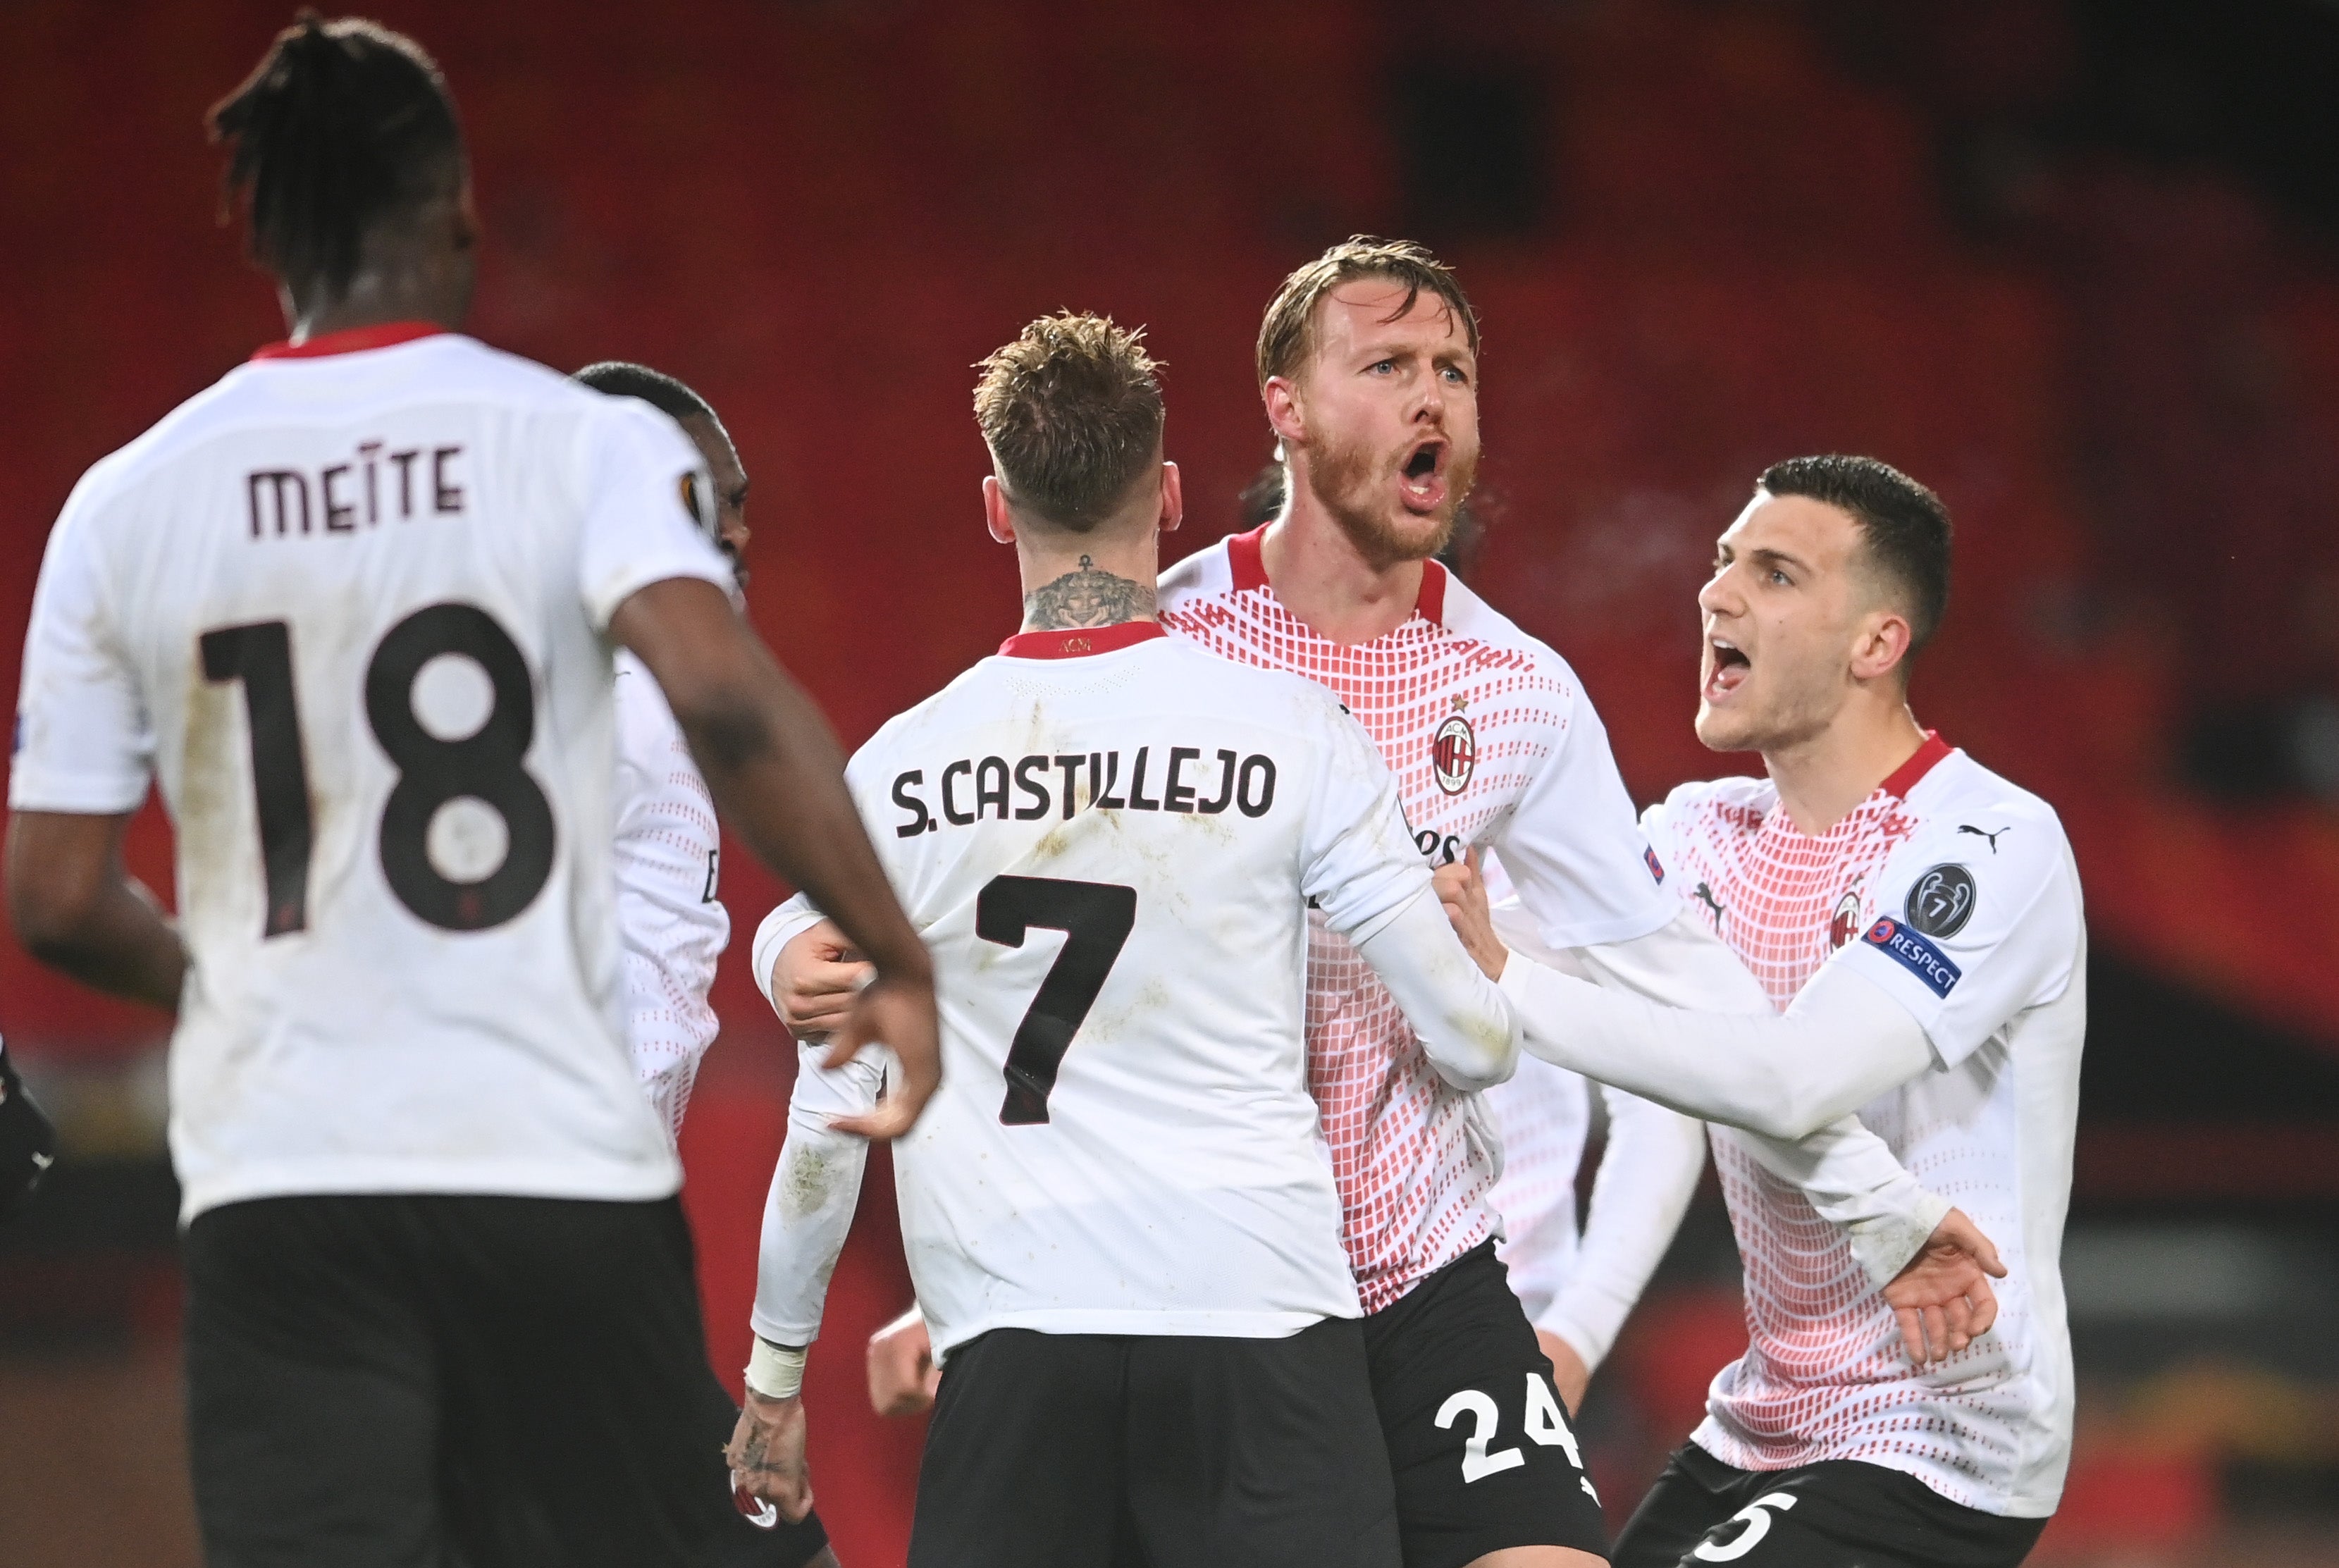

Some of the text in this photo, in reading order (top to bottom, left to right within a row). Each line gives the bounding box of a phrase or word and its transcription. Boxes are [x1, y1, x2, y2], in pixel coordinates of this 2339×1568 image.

[1059, 638, 1092, 652] ACM
[1444, 723, 1467, 739] ACM
[200, 603, 555, 939] 18
[891, 747, 1277, 838] S.CASTILLEJO
[1443, 776, 1462, 786] 1899
[1929, 898, 1946, 918] 7
[1889, 933, 1956, 989] RESPECT
[976, 875, 1137, 1125] 7
[1434, 1372, 1584, 1483] 24
[1694, 1492, 1798, 1562] 5
